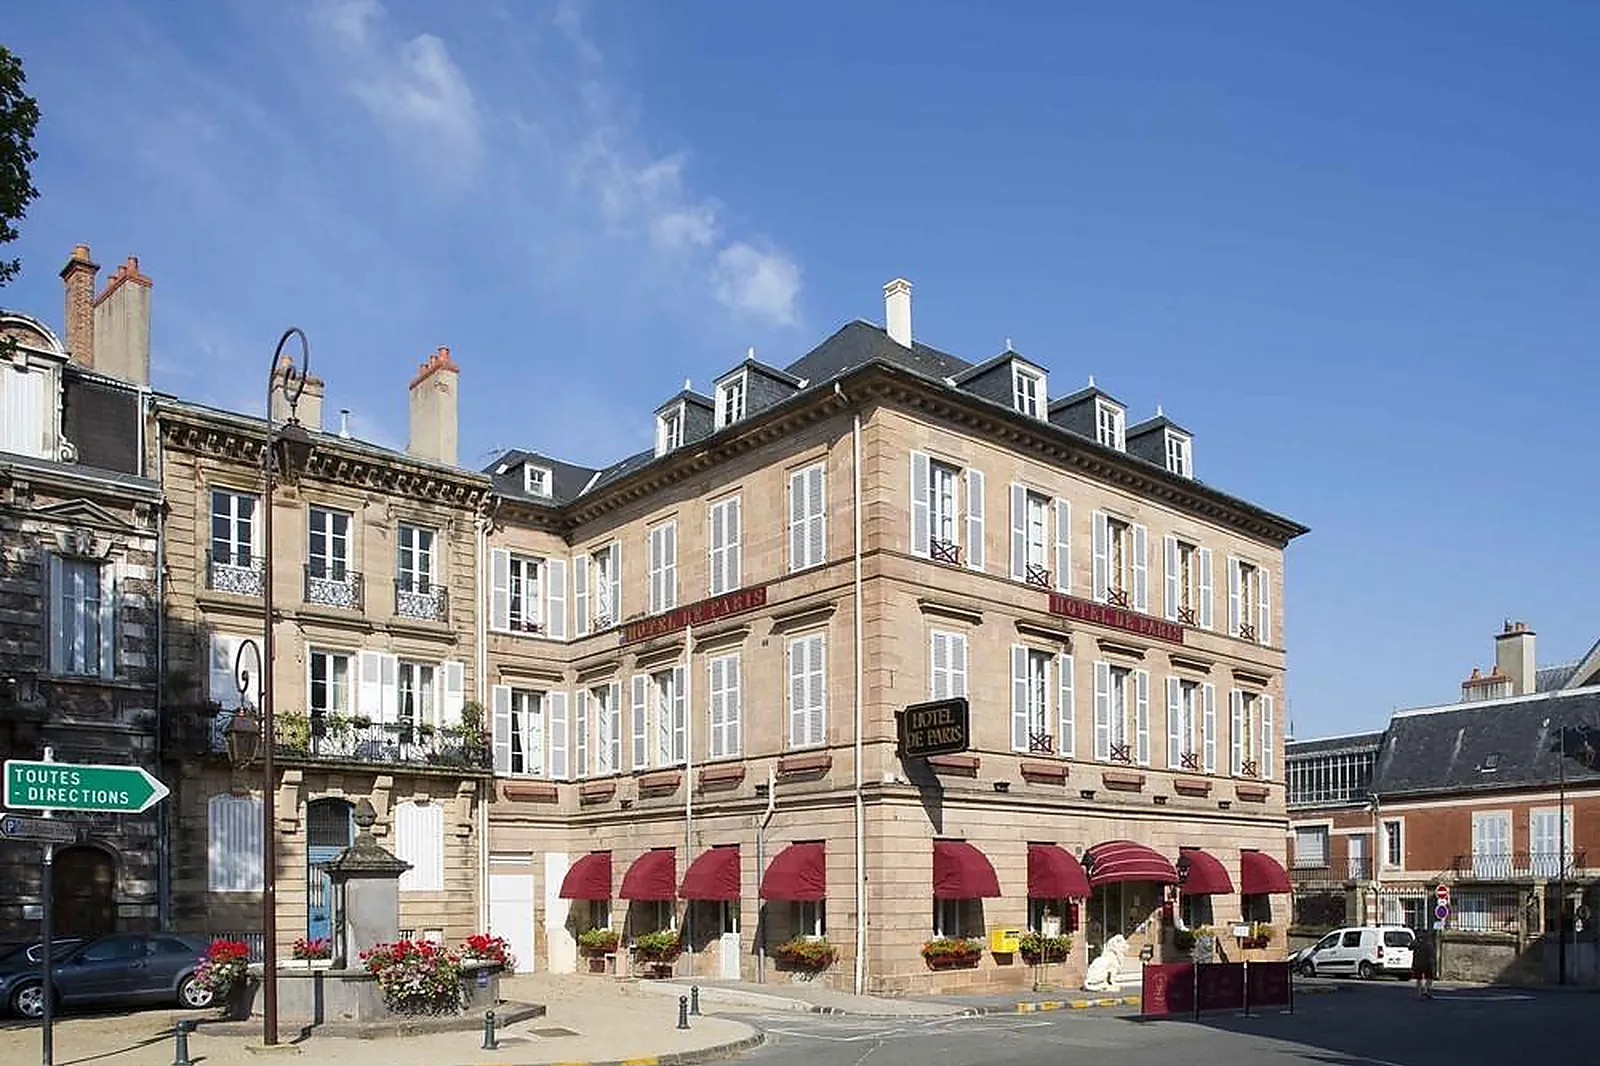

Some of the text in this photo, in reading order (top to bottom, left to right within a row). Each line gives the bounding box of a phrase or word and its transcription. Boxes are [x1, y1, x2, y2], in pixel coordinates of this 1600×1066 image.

[912, 708, 956, 728] HOTEL
[927, 726, 962, 746] PARIS
[15, 769, 81, 785] TOUTES
[28, 787, 129, 804] DIRECTIONS
